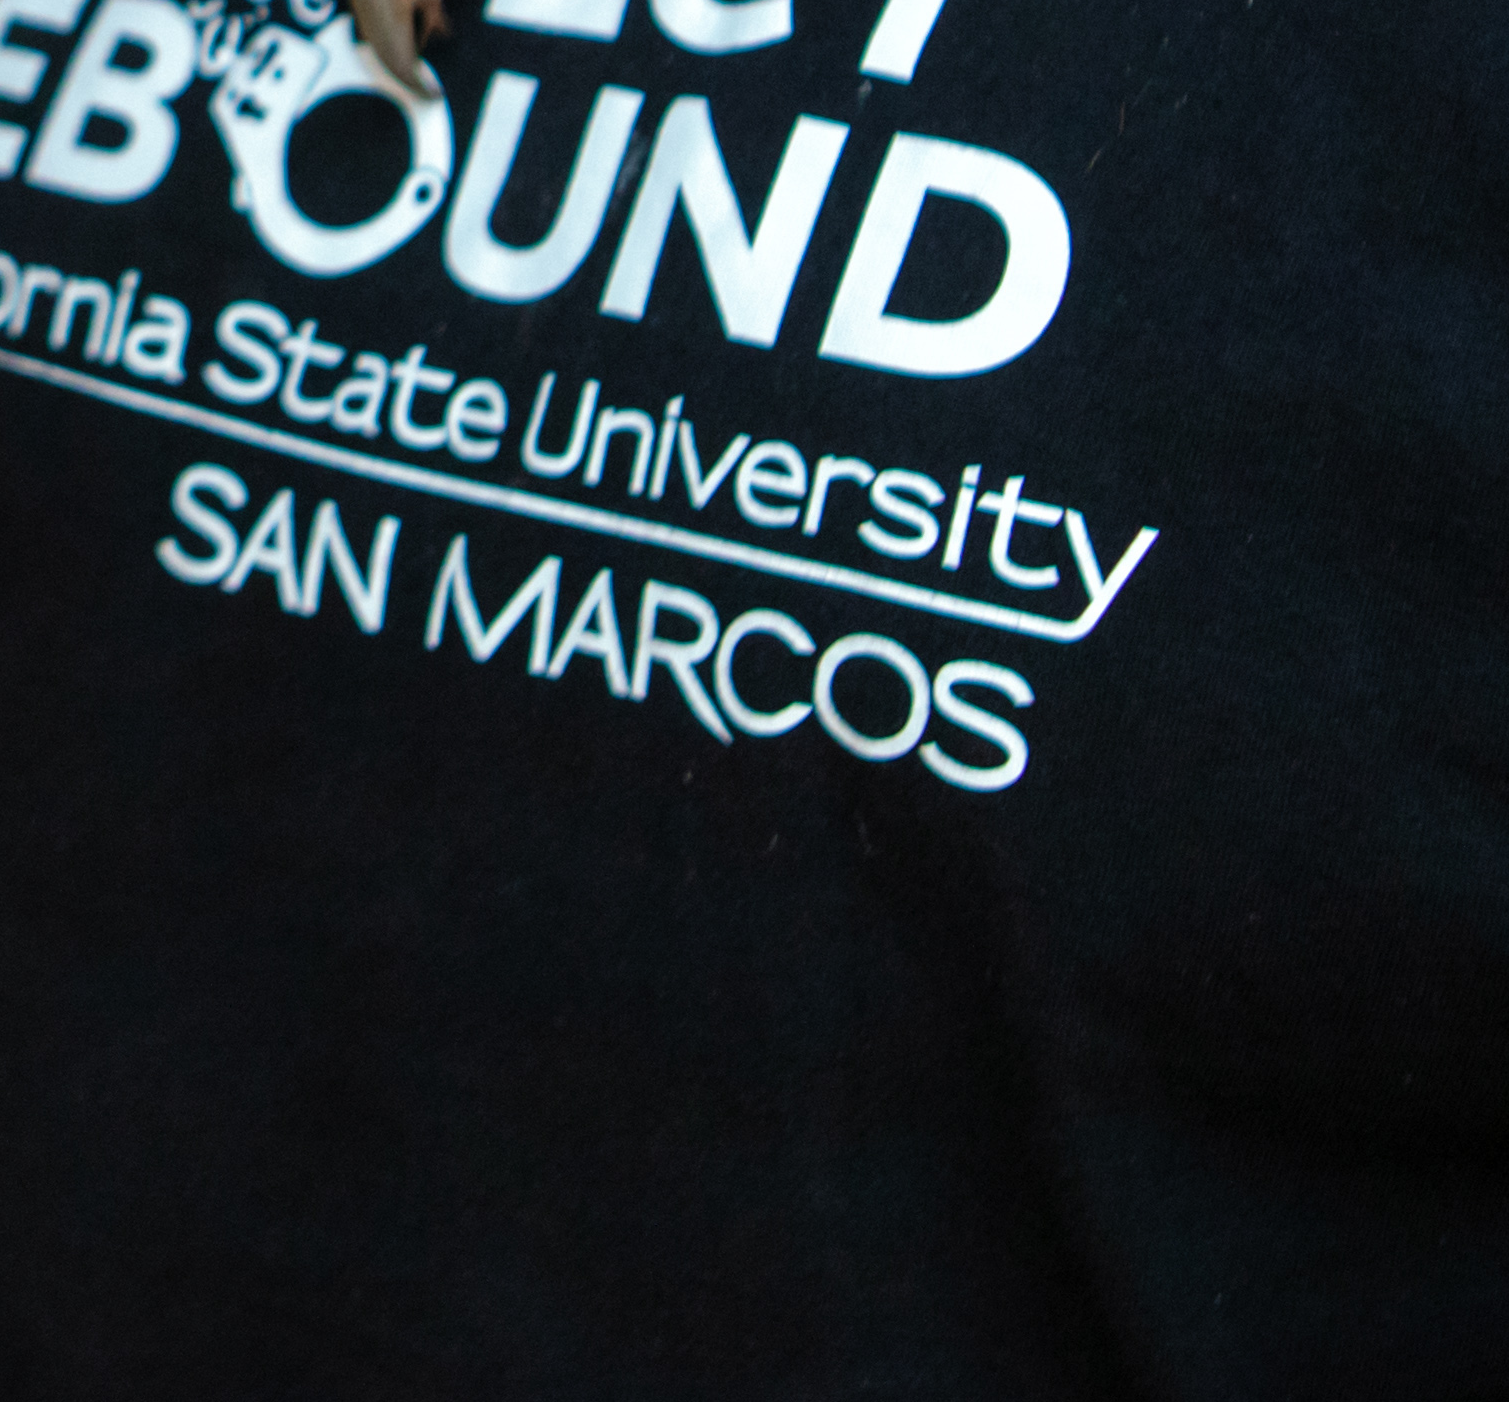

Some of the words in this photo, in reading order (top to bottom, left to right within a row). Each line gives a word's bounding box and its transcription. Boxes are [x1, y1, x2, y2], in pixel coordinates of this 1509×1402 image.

[156, 463, 400, 634] SAN
[426, 534, 1033, 792] MARCOS
[204, 303, 508, 460] State
[522, 370, 1159, 641] University
